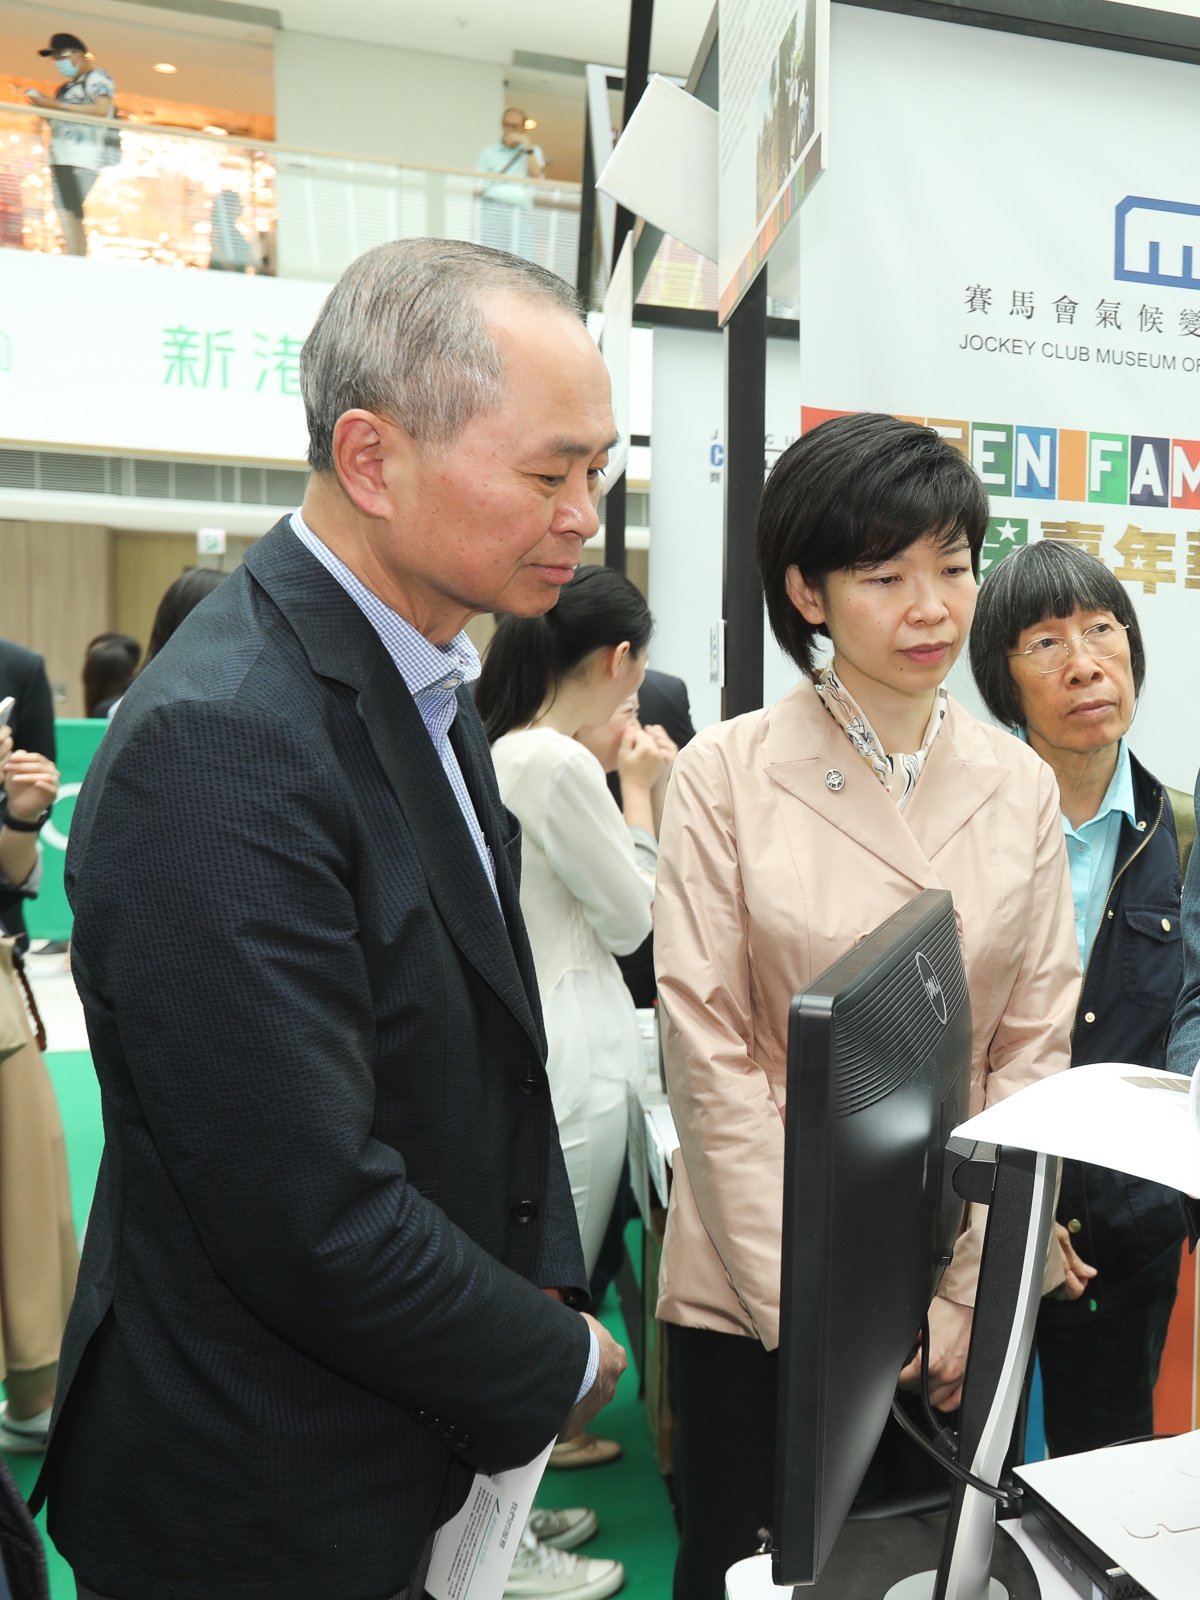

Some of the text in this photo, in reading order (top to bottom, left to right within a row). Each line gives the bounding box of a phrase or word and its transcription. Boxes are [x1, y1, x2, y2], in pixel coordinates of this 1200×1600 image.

[959, 334, 1036, 355] JOCKEY
[1041, 342, 1090, 362] CLUB
[1096, 348, 1176, 371] MUSEUM
[927, 426, 1051, 488] EN
